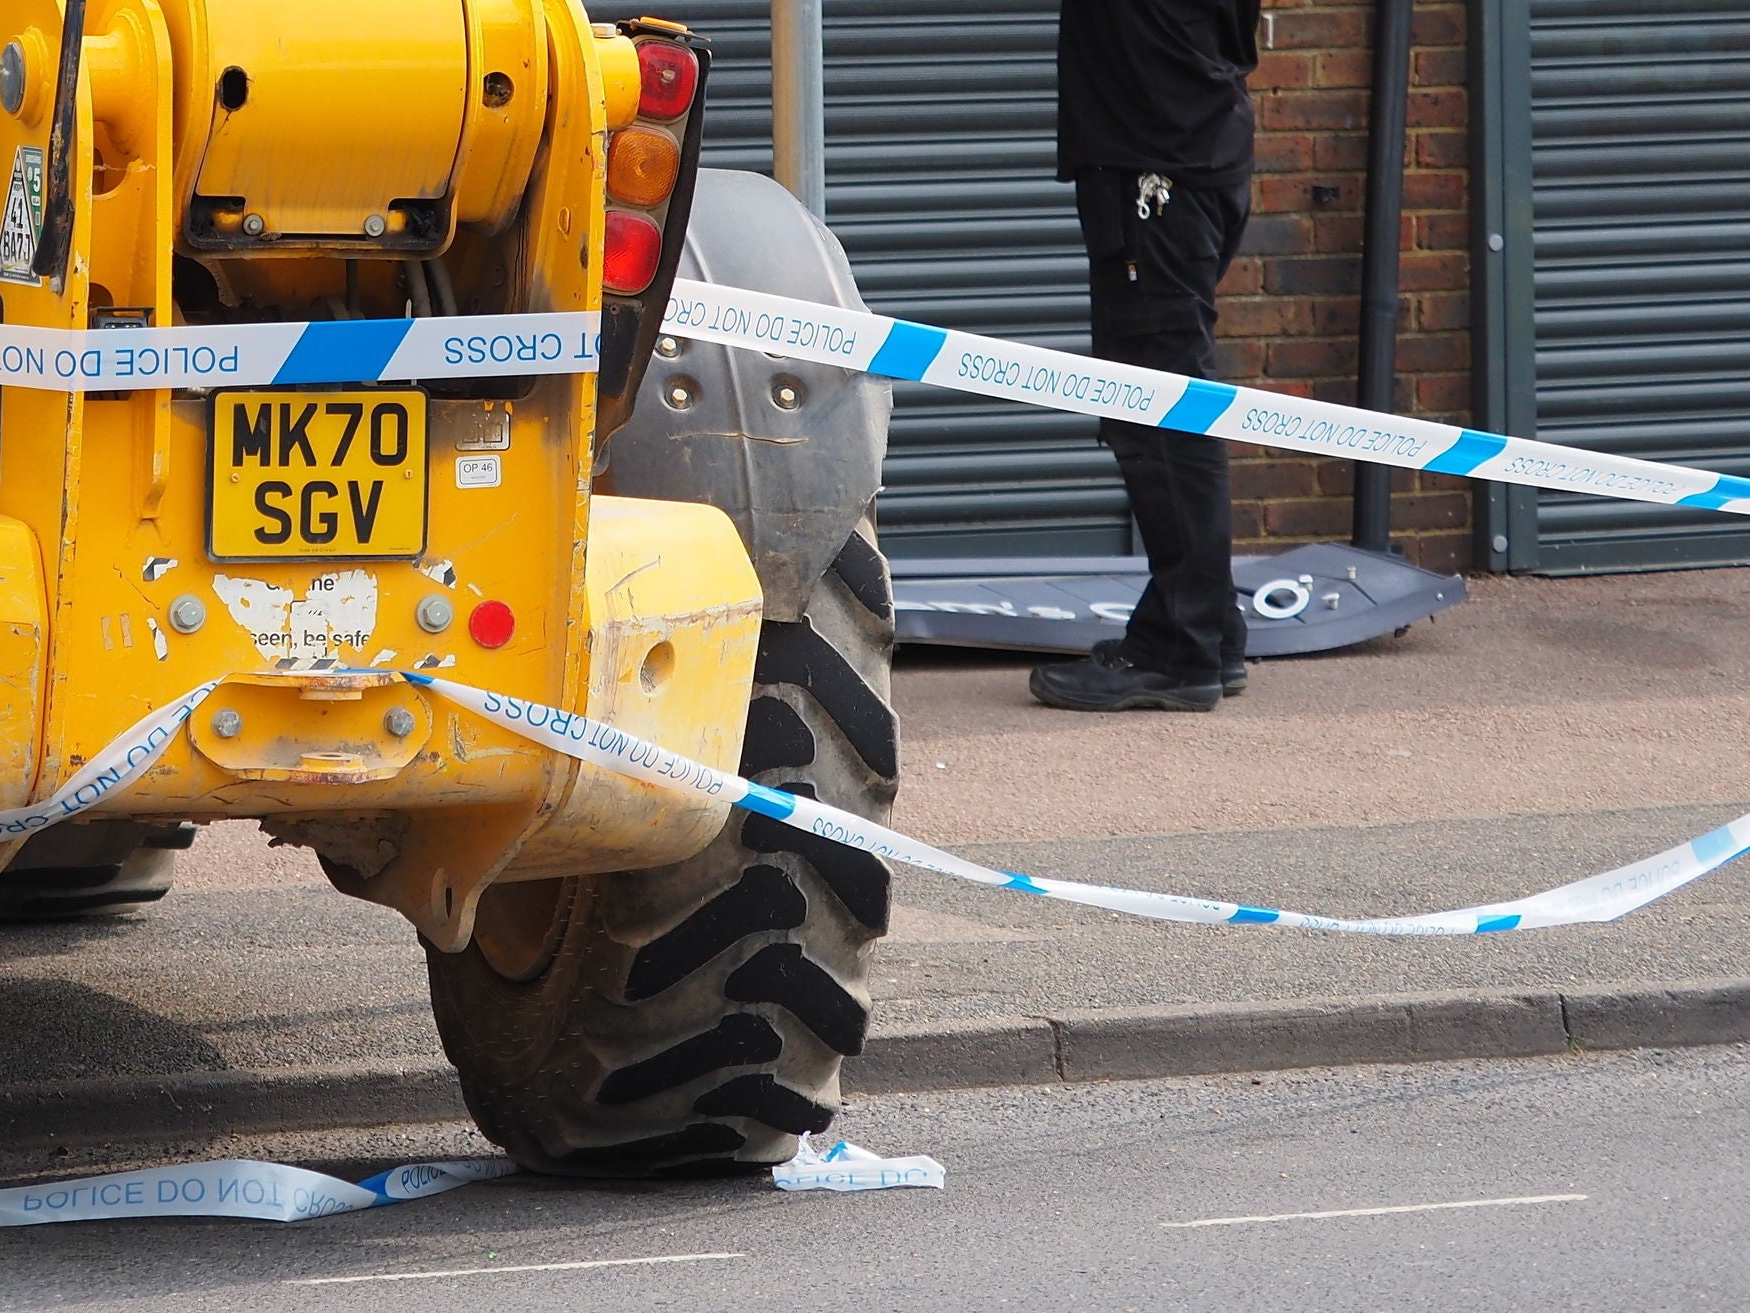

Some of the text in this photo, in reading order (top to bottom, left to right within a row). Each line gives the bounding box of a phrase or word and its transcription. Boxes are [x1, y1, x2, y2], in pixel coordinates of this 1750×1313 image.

[444, 333, 562, 365] CROSS
[663, 296, 857, 356] POLICE DO NOT CRO
[55, 350, 101, 378] DO
[116, 345, 239, 377] POLICE
[958, 352, 1156, 412] POLICE DO NOT CROSS
[232, 402, 408, 469] MK70
[1240, 408, 1428, 458] POLICE DO NOT CROSS
[463, 463, 493, 473] OP 46
[1503, 456, 1567, 481] CROSS
[253, 480, 384, 545] SGV
[303, 630, 326, 647] be
[484, 690, 724, 795] POLICE DO NOT CROSS
[60, 765, 120, 816] NOT
